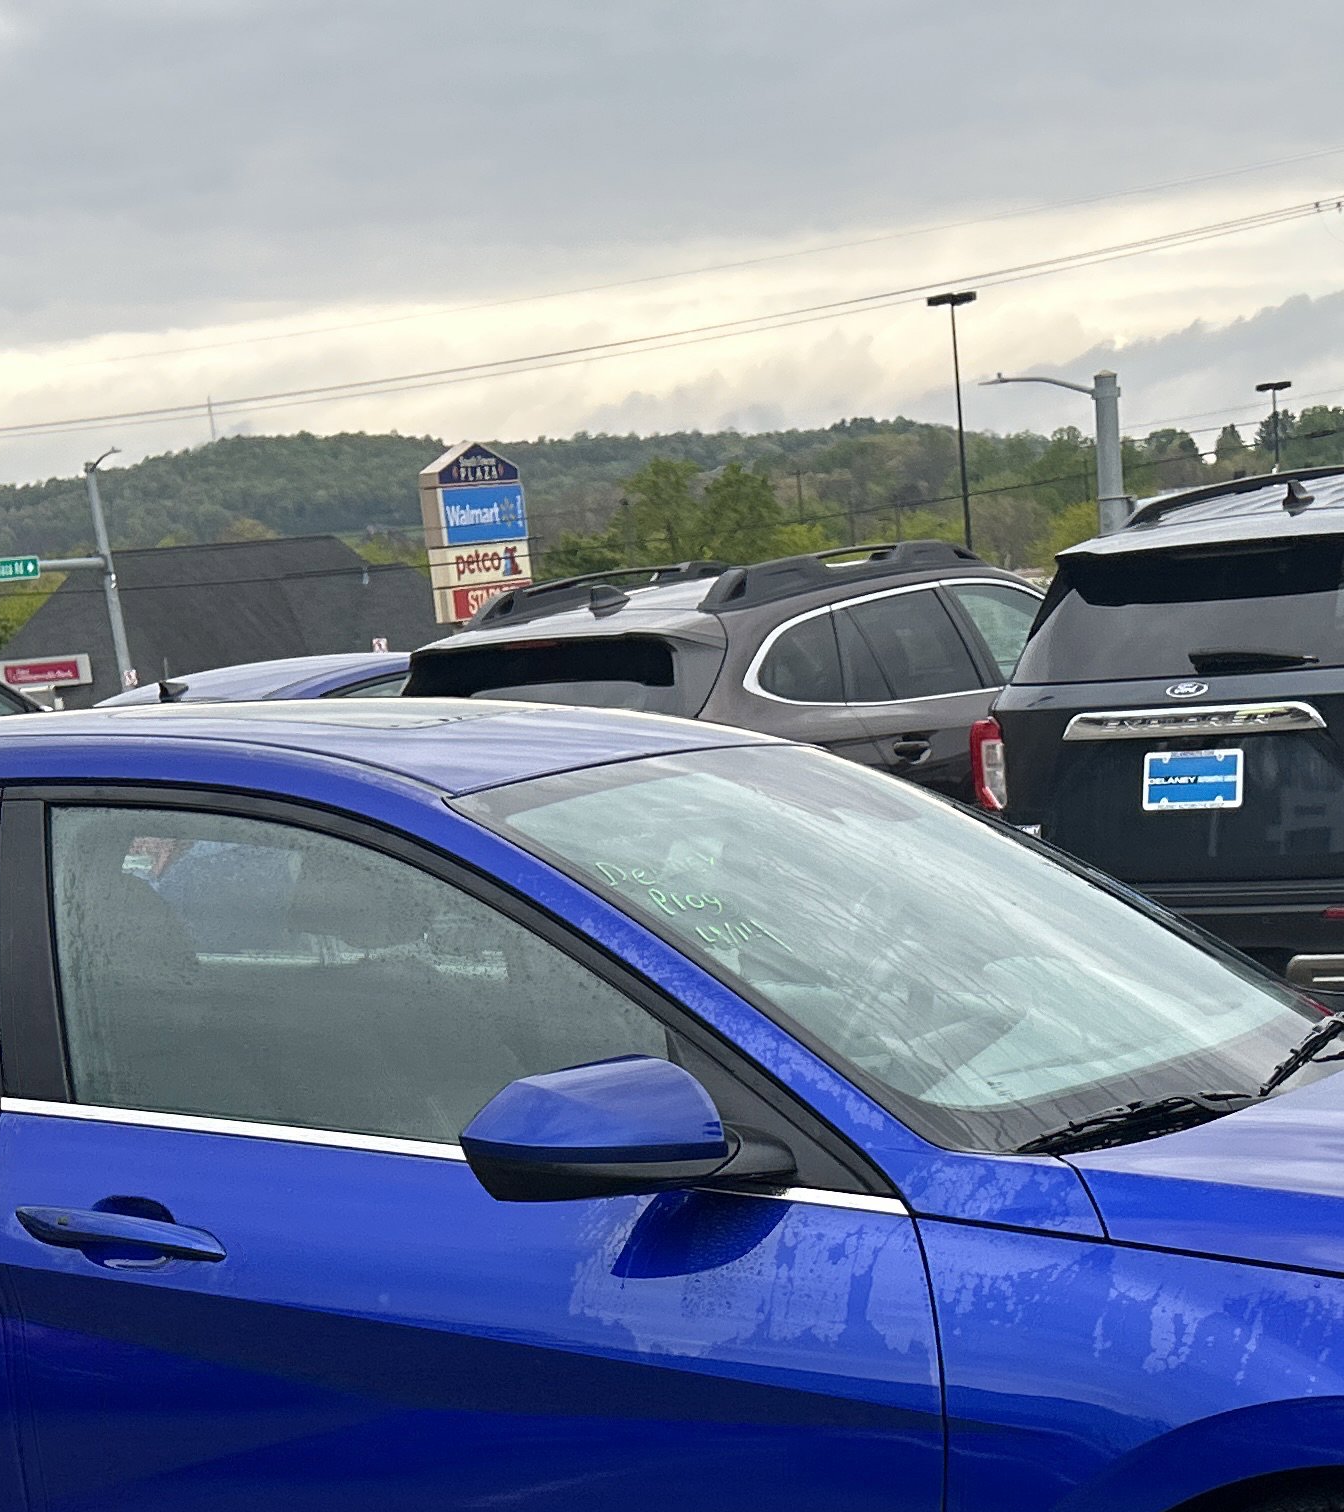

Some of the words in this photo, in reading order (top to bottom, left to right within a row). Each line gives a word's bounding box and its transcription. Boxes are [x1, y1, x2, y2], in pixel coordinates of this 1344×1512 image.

[445, 501, 500, 527] Walmart
[455, 549, 501, 581] petco
[1148, 776, 1196, 785] DELANEY
